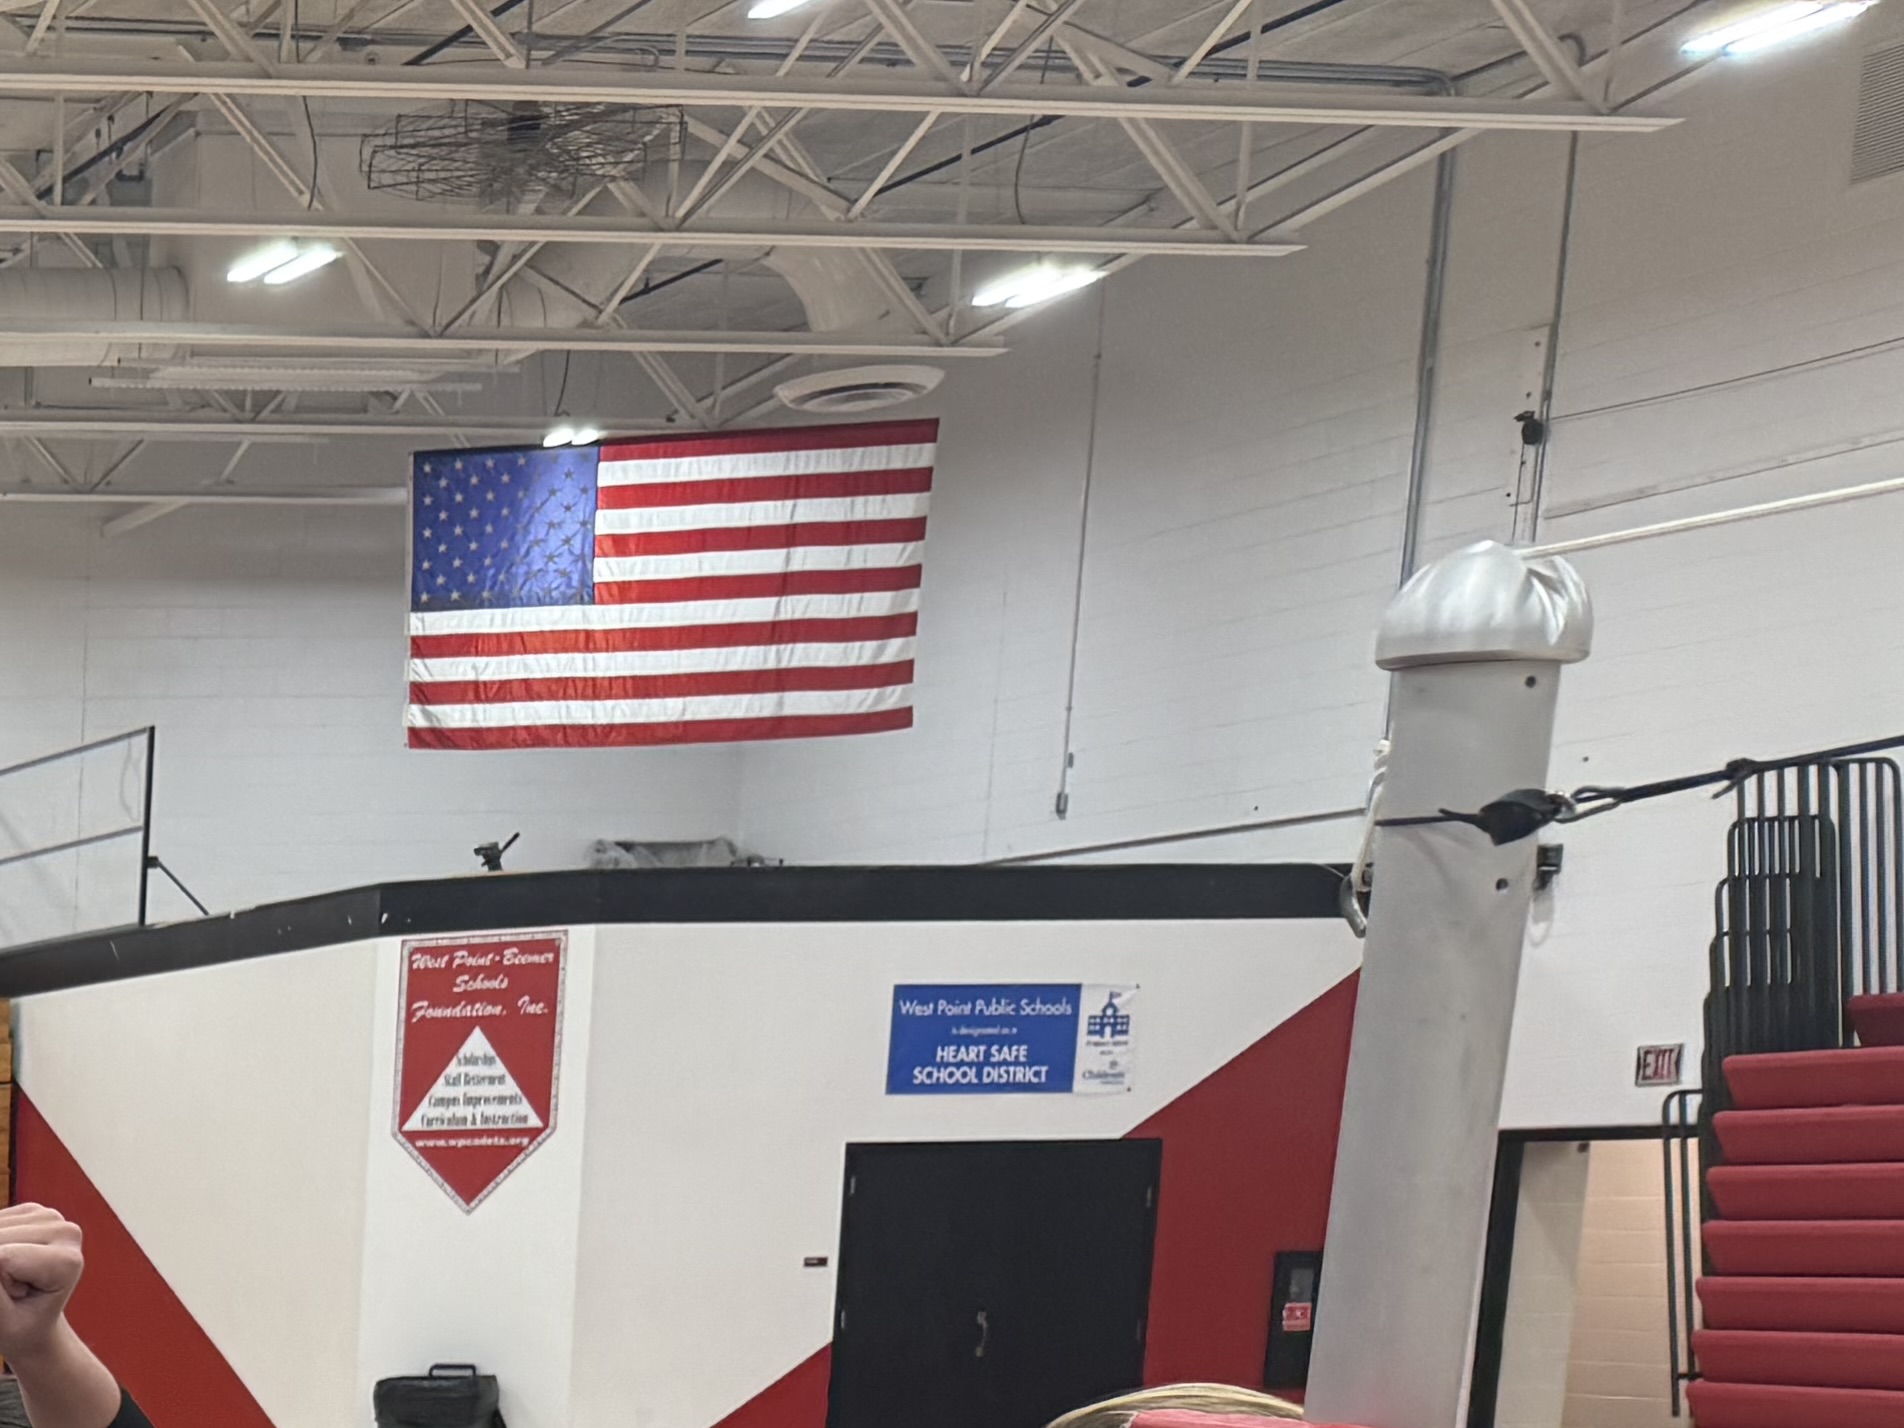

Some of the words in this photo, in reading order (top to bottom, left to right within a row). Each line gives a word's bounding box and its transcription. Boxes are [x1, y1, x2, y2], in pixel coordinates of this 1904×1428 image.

[411, 953, 449, 969] West
[453, 972, 508, 992] Schools
[411, 1000, 507, 1023] Foundation,
[517, 995, 548, 1015] Inc.
[899, 1000, 934, 1016] West
[938, 999, 972, 1015] Point
[975, 997, 1016, 1016] Public
[1020, 997, 1072, 1015] Schools
[936, 1045, 987, 1062] HEART
[990, 1045, 1028, 1062] SAFE
[1642, 1048, 1675, 1081] EXIT
[912, 1066, 978, 1084] SCHOOL
[982, 1065, 1049, 1083] DISTRICT
